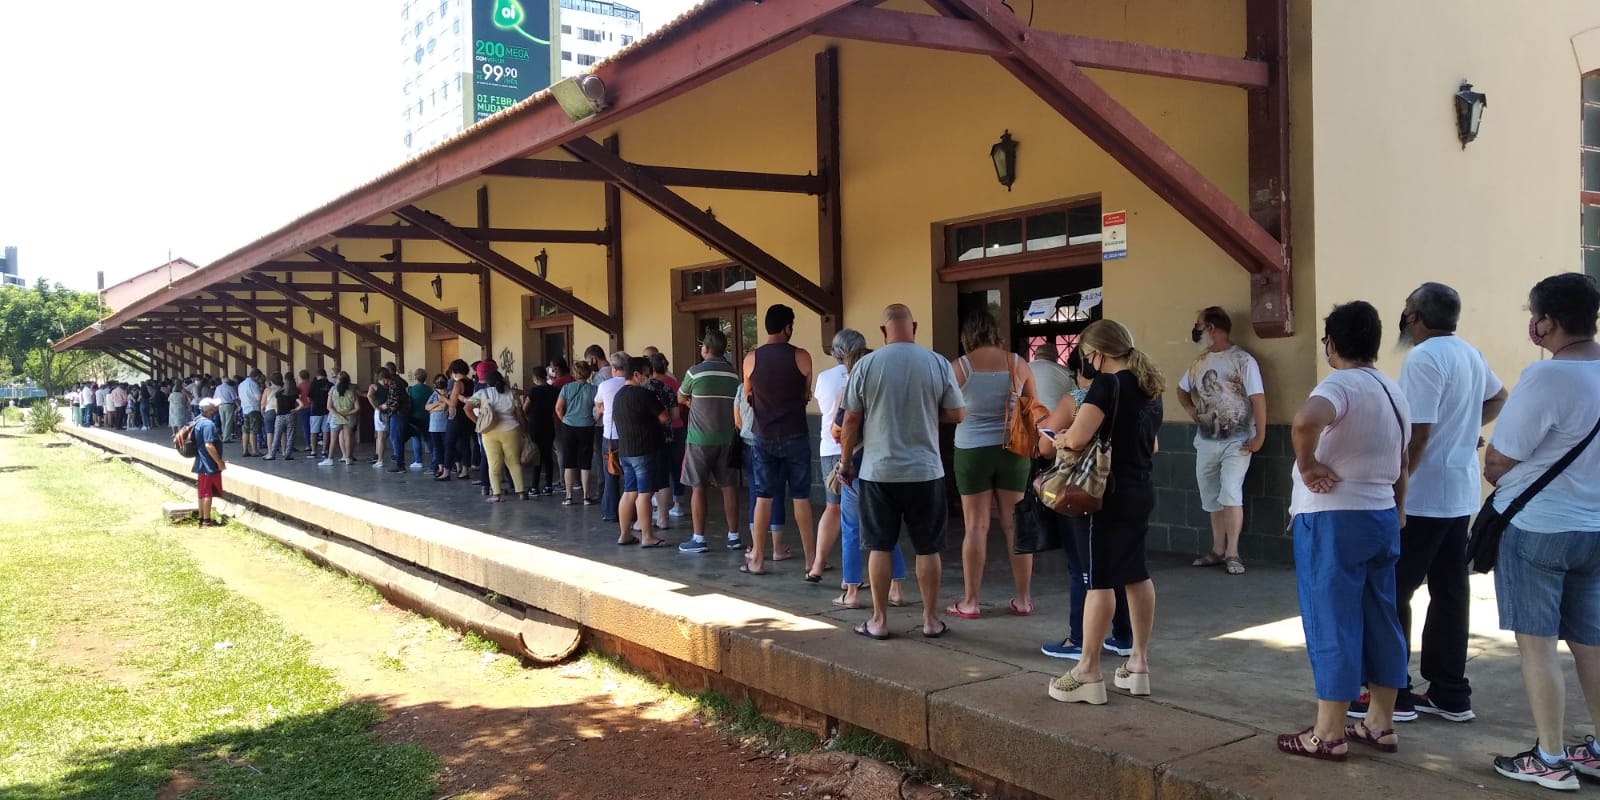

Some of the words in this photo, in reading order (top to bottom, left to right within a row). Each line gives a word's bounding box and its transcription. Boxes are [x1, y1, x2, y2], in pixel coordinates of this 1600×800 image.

[501, 4, 515, 19] oi
[475, 39, 505, 58] 200
[505, 48, 529, 58] MEGA
[477, 94, 488, 103] OI
[490, 95, 518, 106] FIBRA
